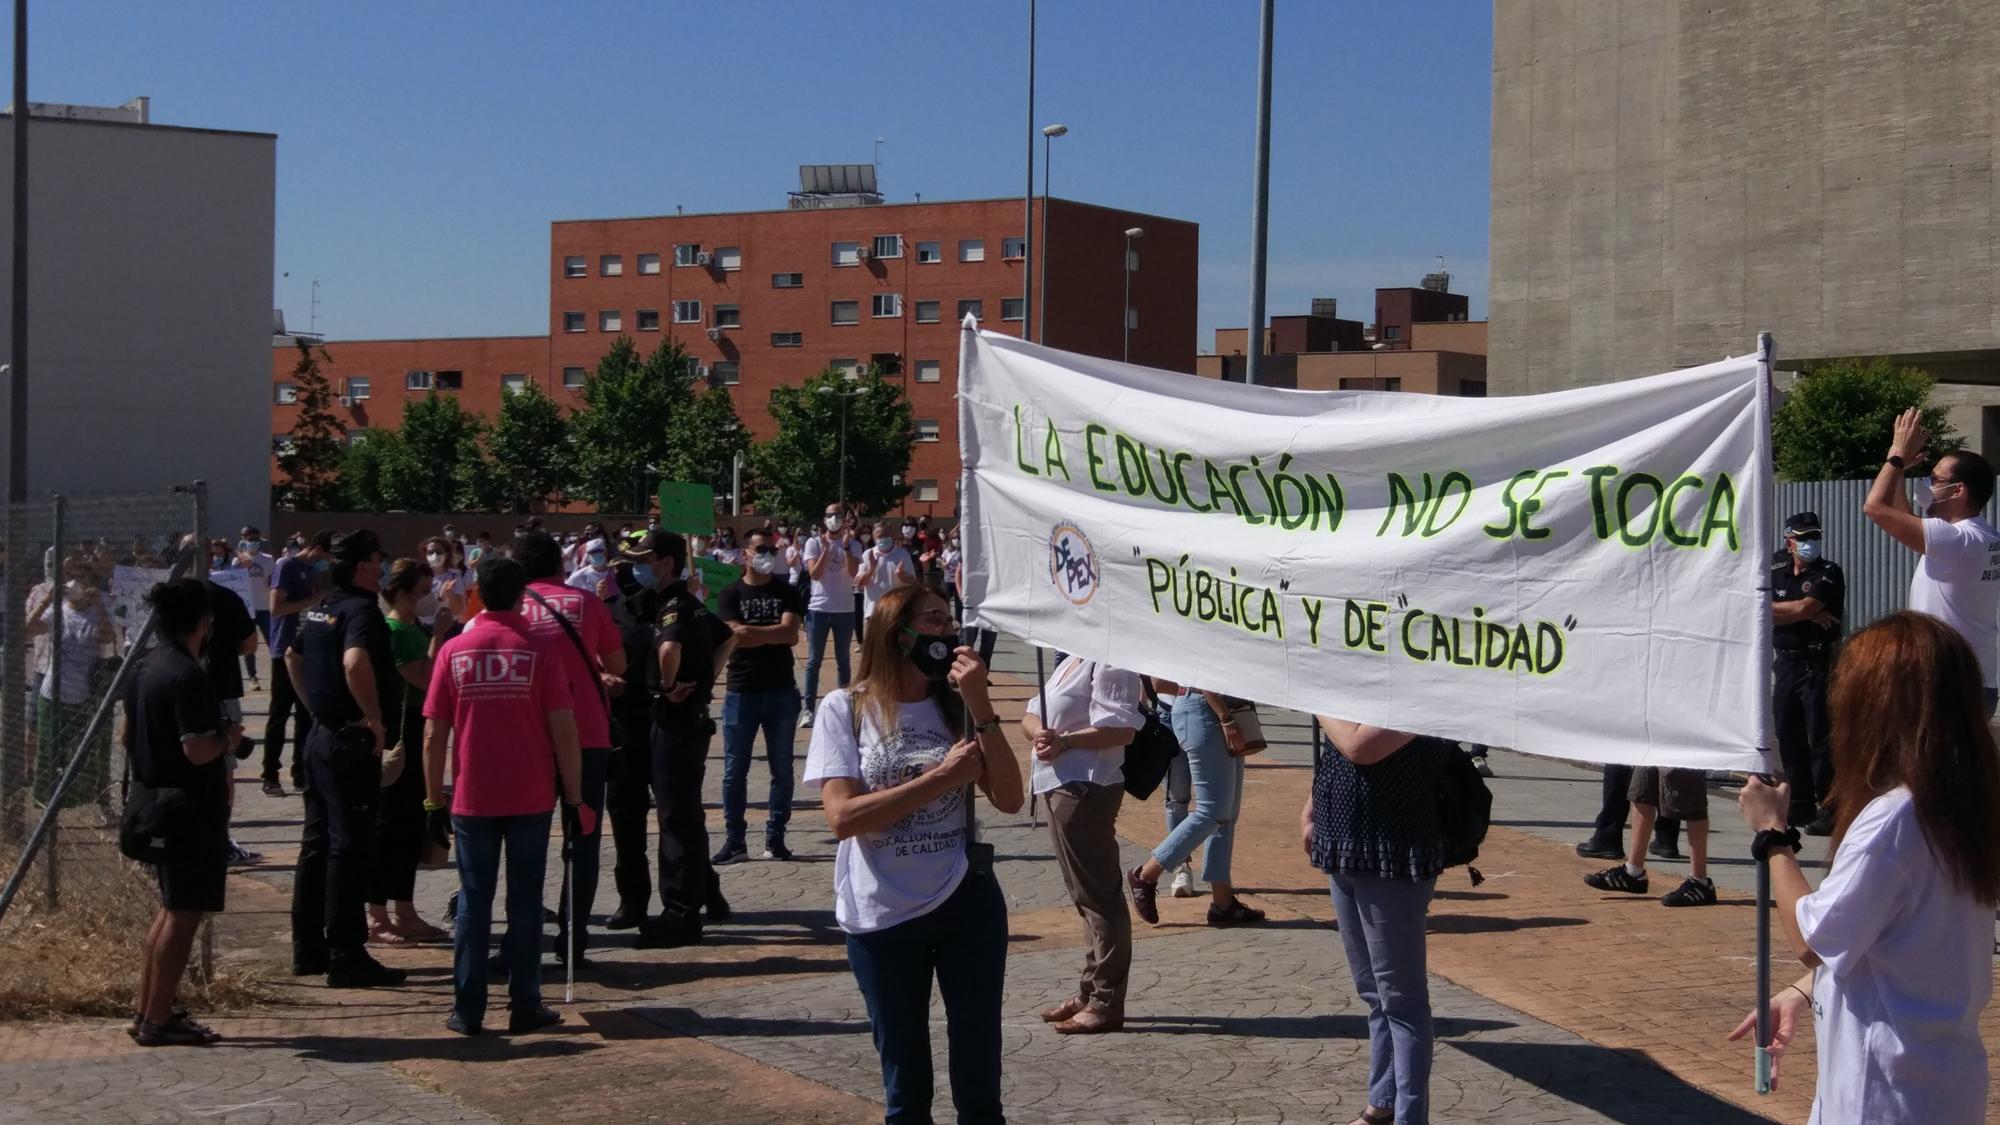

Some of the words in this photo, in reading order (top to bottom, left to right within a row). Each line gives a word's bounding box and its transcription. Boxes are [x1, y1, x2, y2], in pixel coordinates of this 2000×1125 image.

[1014, 404, 1071, 482] LA
[1376, 470, 1473, 538] NO
[1483, 469, 1569, 540] SE
[1582, 464, 1739, 552] TOCA
[1066, 552, 1097, 594] PEX
[1301, 597, 1321, 645] Y
[1344, 598, 1387, 652] DE
